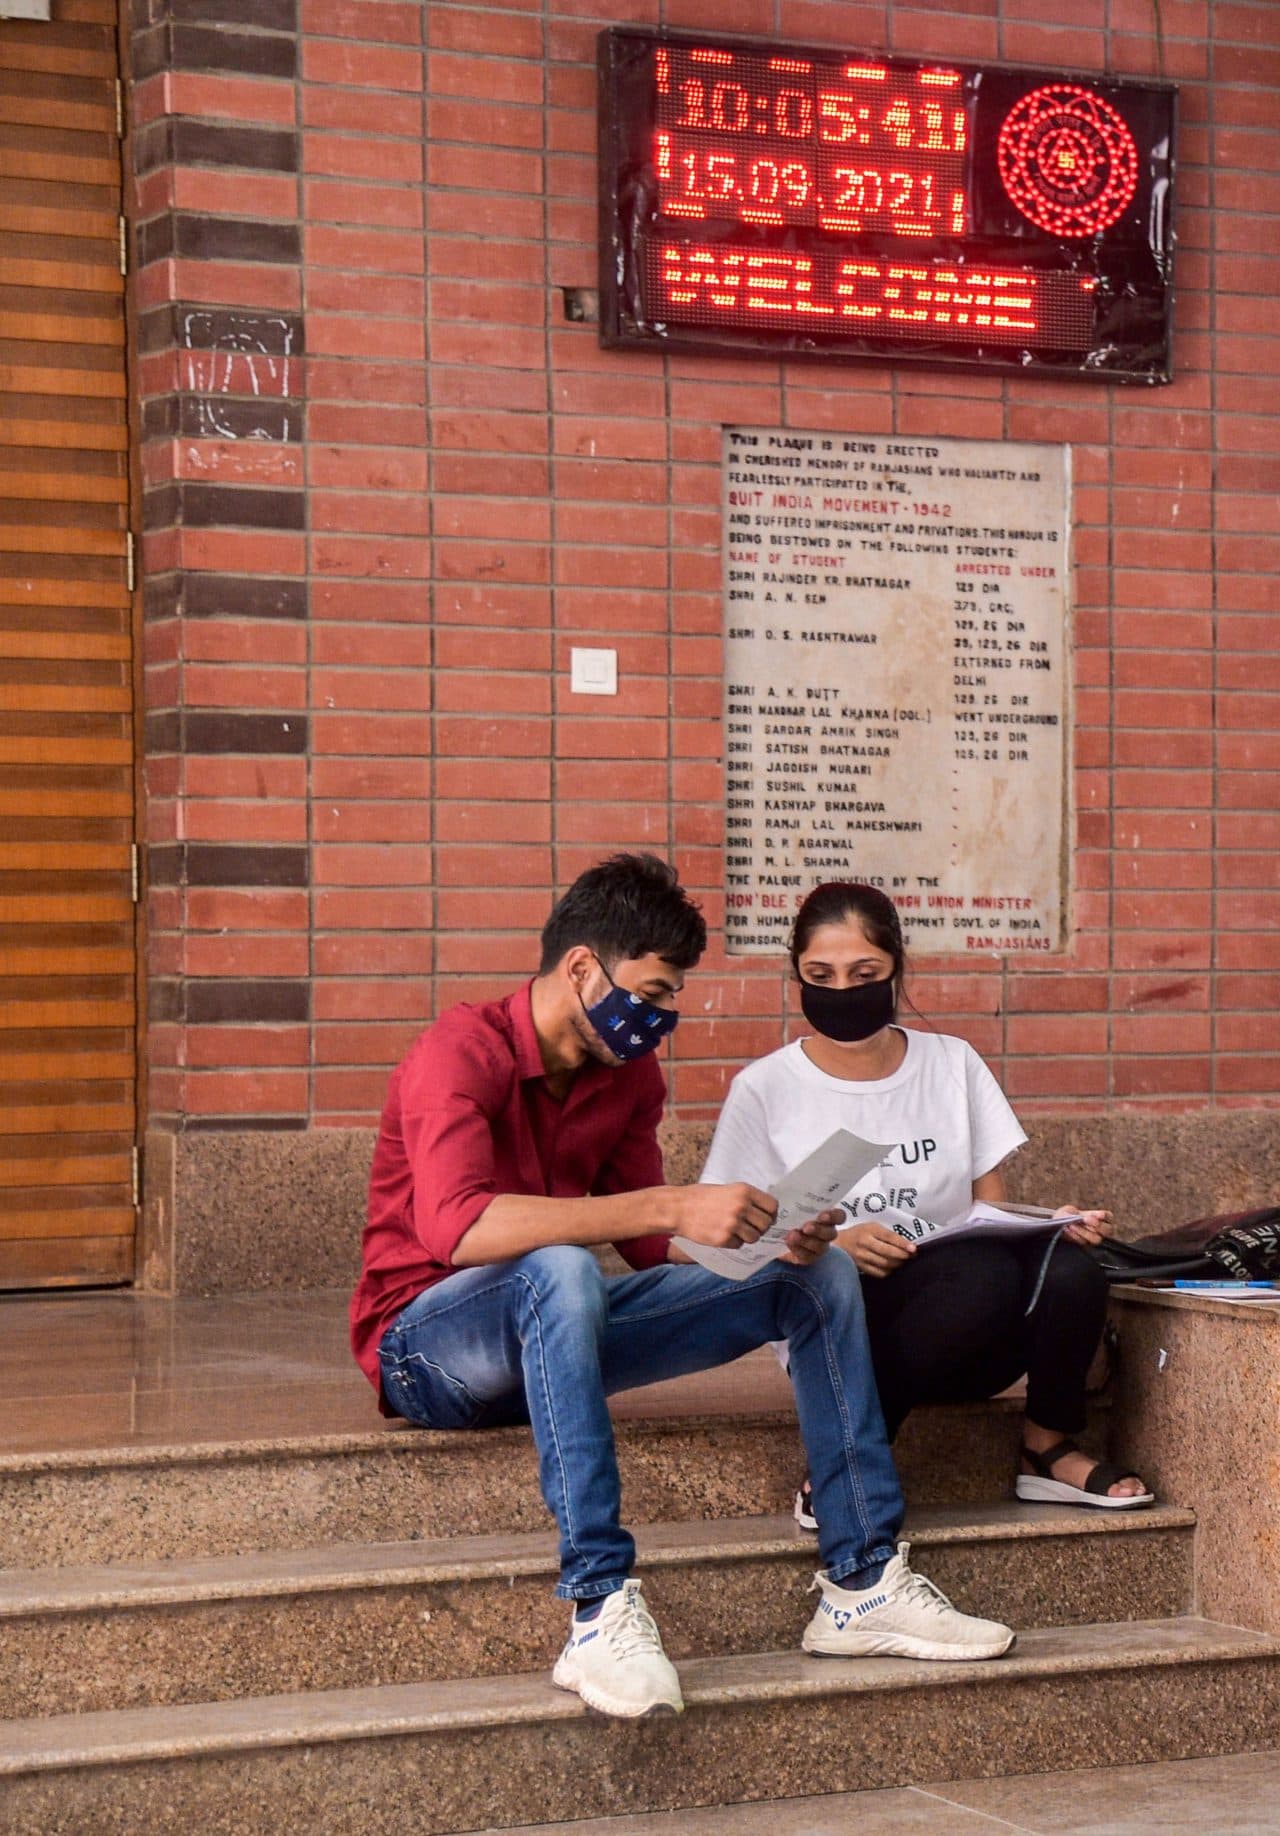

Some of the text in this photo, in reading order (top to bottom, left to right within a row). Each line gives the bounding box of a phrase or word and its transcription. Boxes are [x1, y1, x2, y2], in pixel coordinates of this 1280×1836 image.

[676, 79, 952, 150] 10:05:41
[683, 153, 942, 218] 15.09.2021
[900, 1138, 936, 1164] UP
